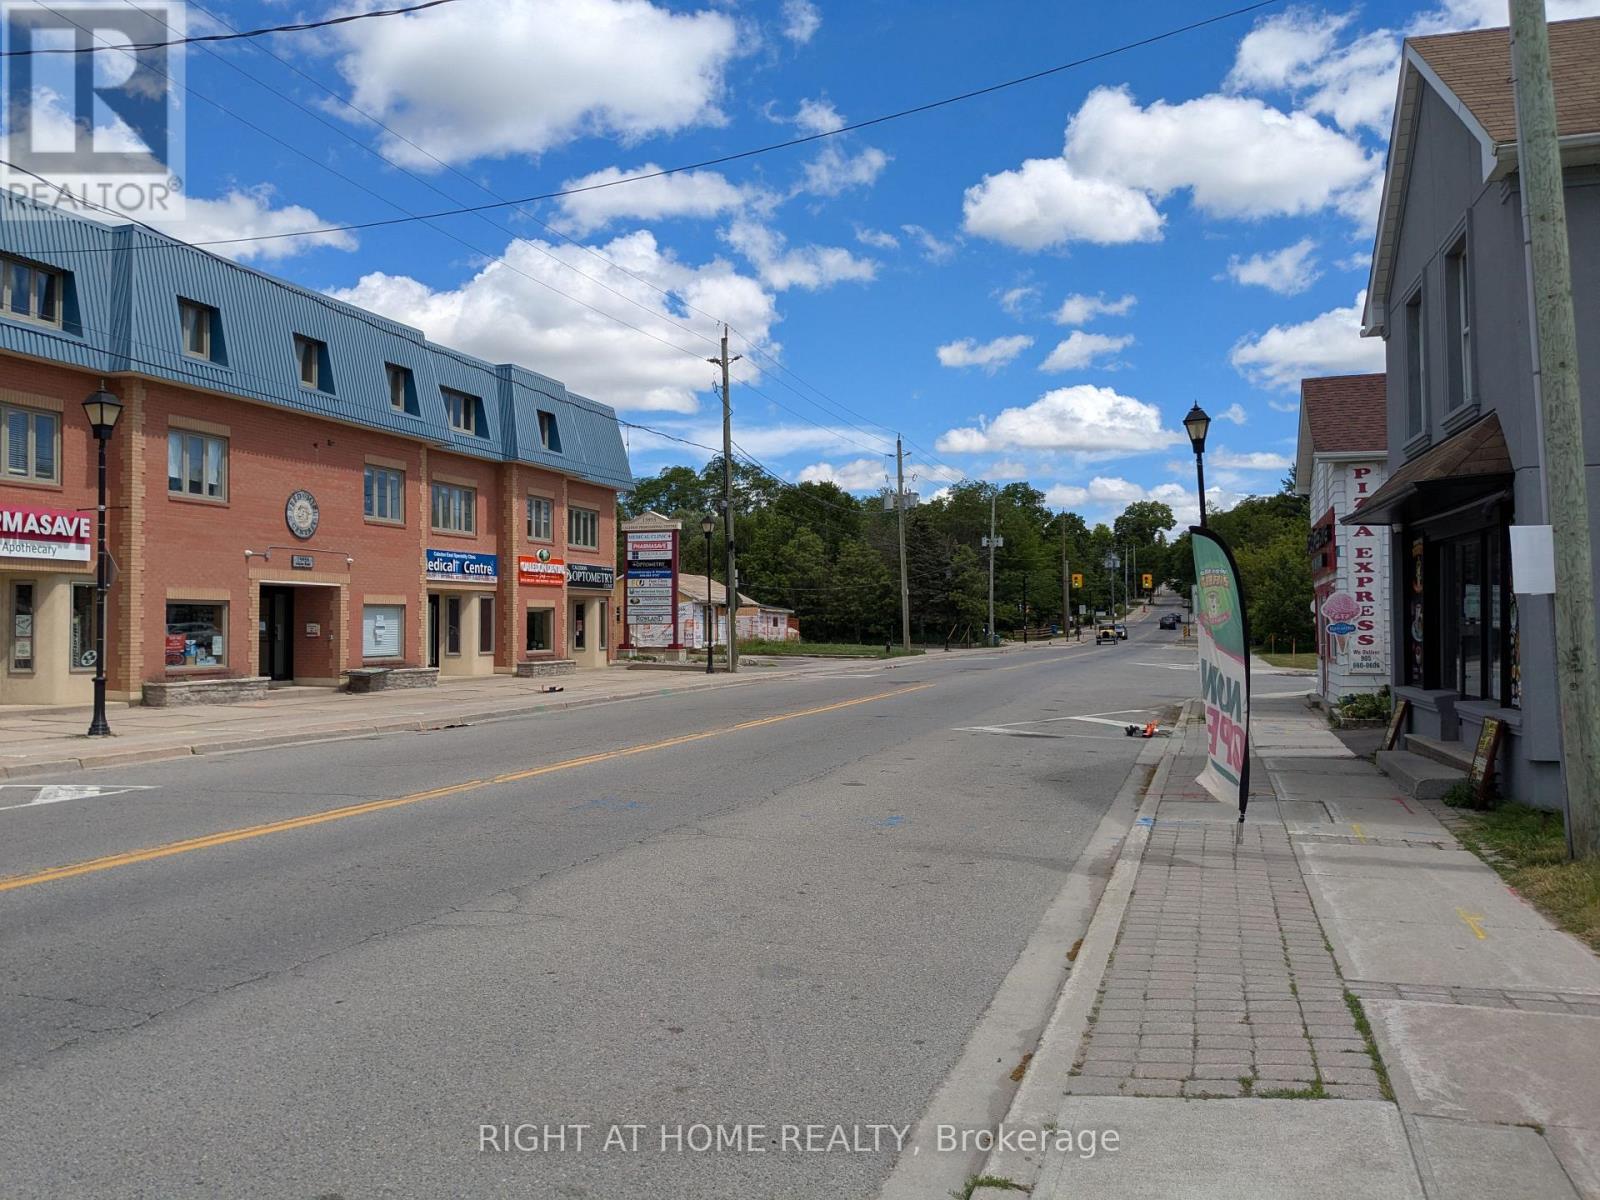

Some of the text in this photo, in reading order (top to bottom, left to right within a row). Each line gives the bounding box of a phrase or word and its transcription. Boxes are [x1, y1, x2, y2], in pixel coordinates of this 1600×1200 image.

[0, 511, 91, 538] MASAVE
[2, 542, 57, 557] Apothecary
[427, 558, 493, 575] edical Centre
[572, 570, 613, 584] OPTOMETRY
[1353, 547, 1375, 646] EXPRESS
